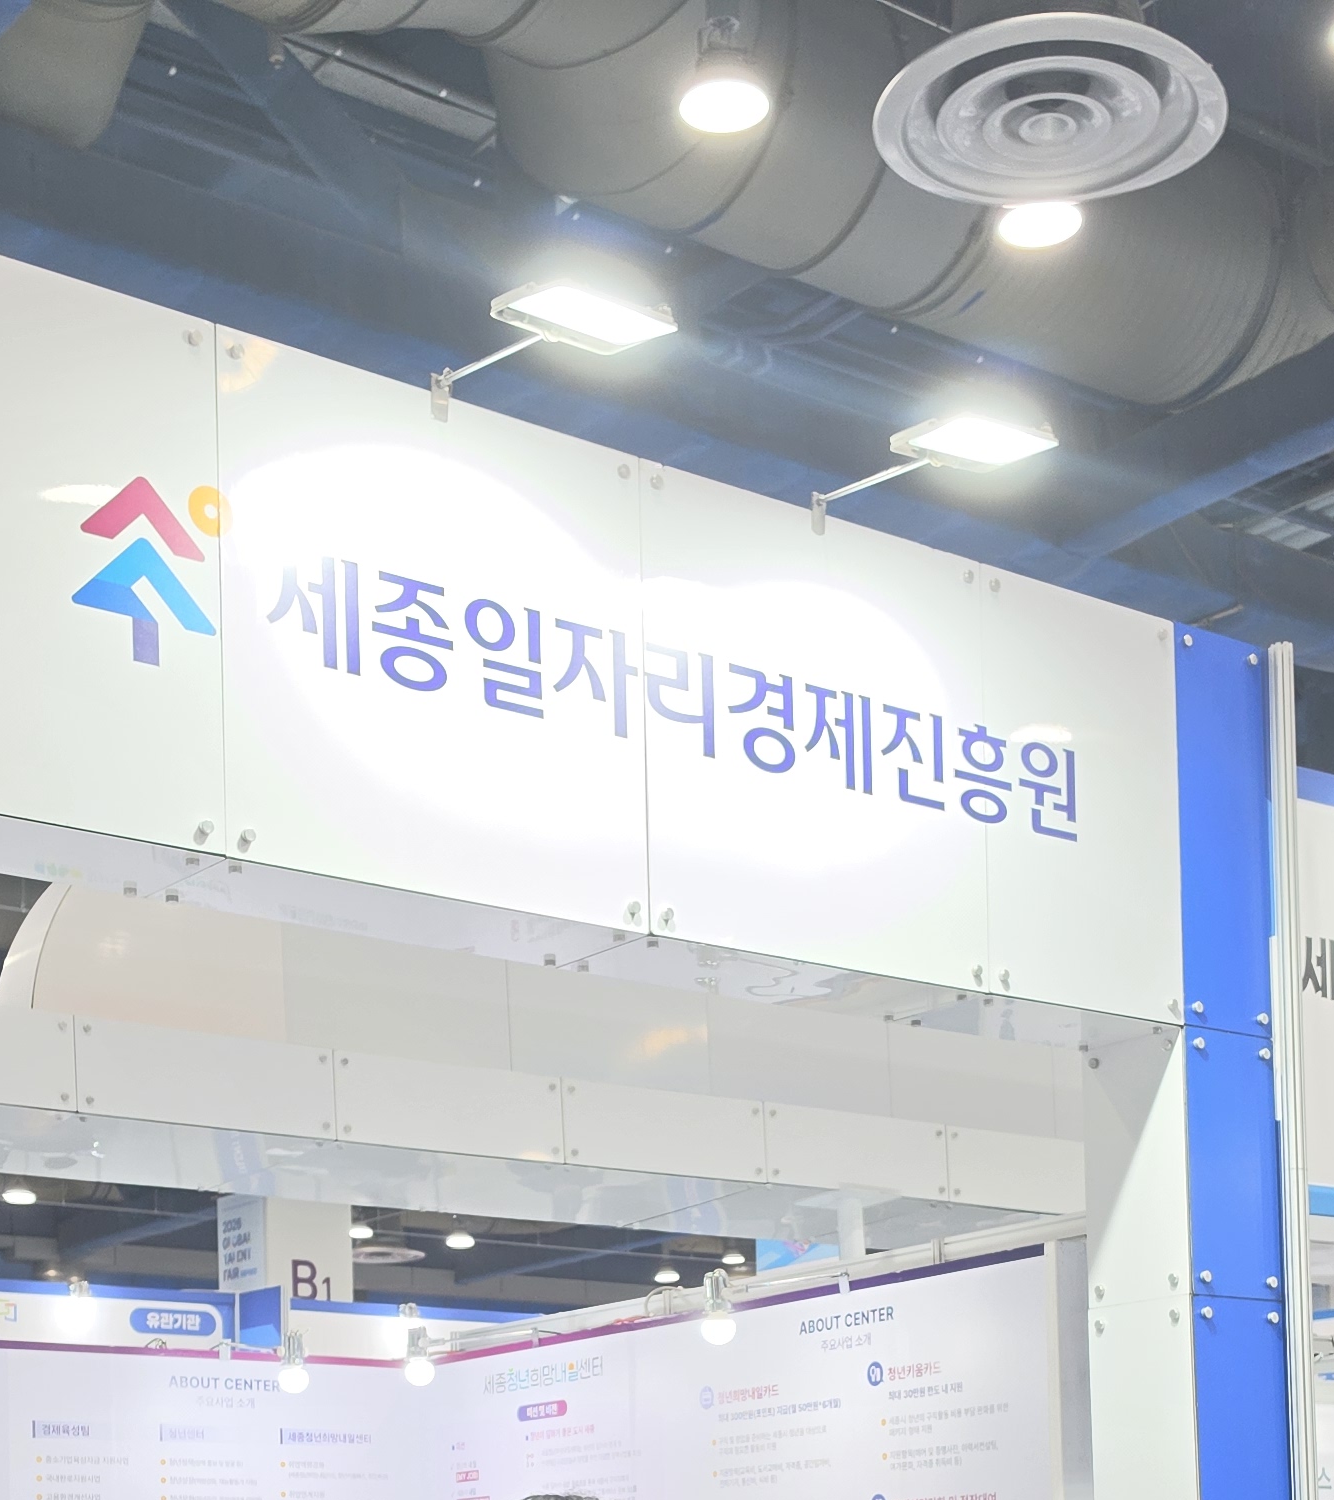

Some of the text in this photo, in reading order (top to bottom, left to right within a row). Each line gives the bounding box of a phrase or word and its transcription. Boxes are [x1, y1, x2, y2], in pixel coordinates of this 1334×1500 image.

[267, 555, 1079, 842] 세종일자리경제진흥원
[291, 1259, 332, 1301] B1
[146, 1312, 201, 1332] 유관기관
[799, 1306, 894, 1335] ABOUT CENTER
[821, 1333, 872, 1352] 주요사업 소개
[483, 1355, 604, 1396] 세종청년희망내일센터
[887, 1361, 942, 1381] 청년키움카드
[169, 1375, 281, 1392] ABOUT CENTER
[237, 1398, 255, 1409] 소개
[717, 1384, 779, 1405] 청년희망내일카드
